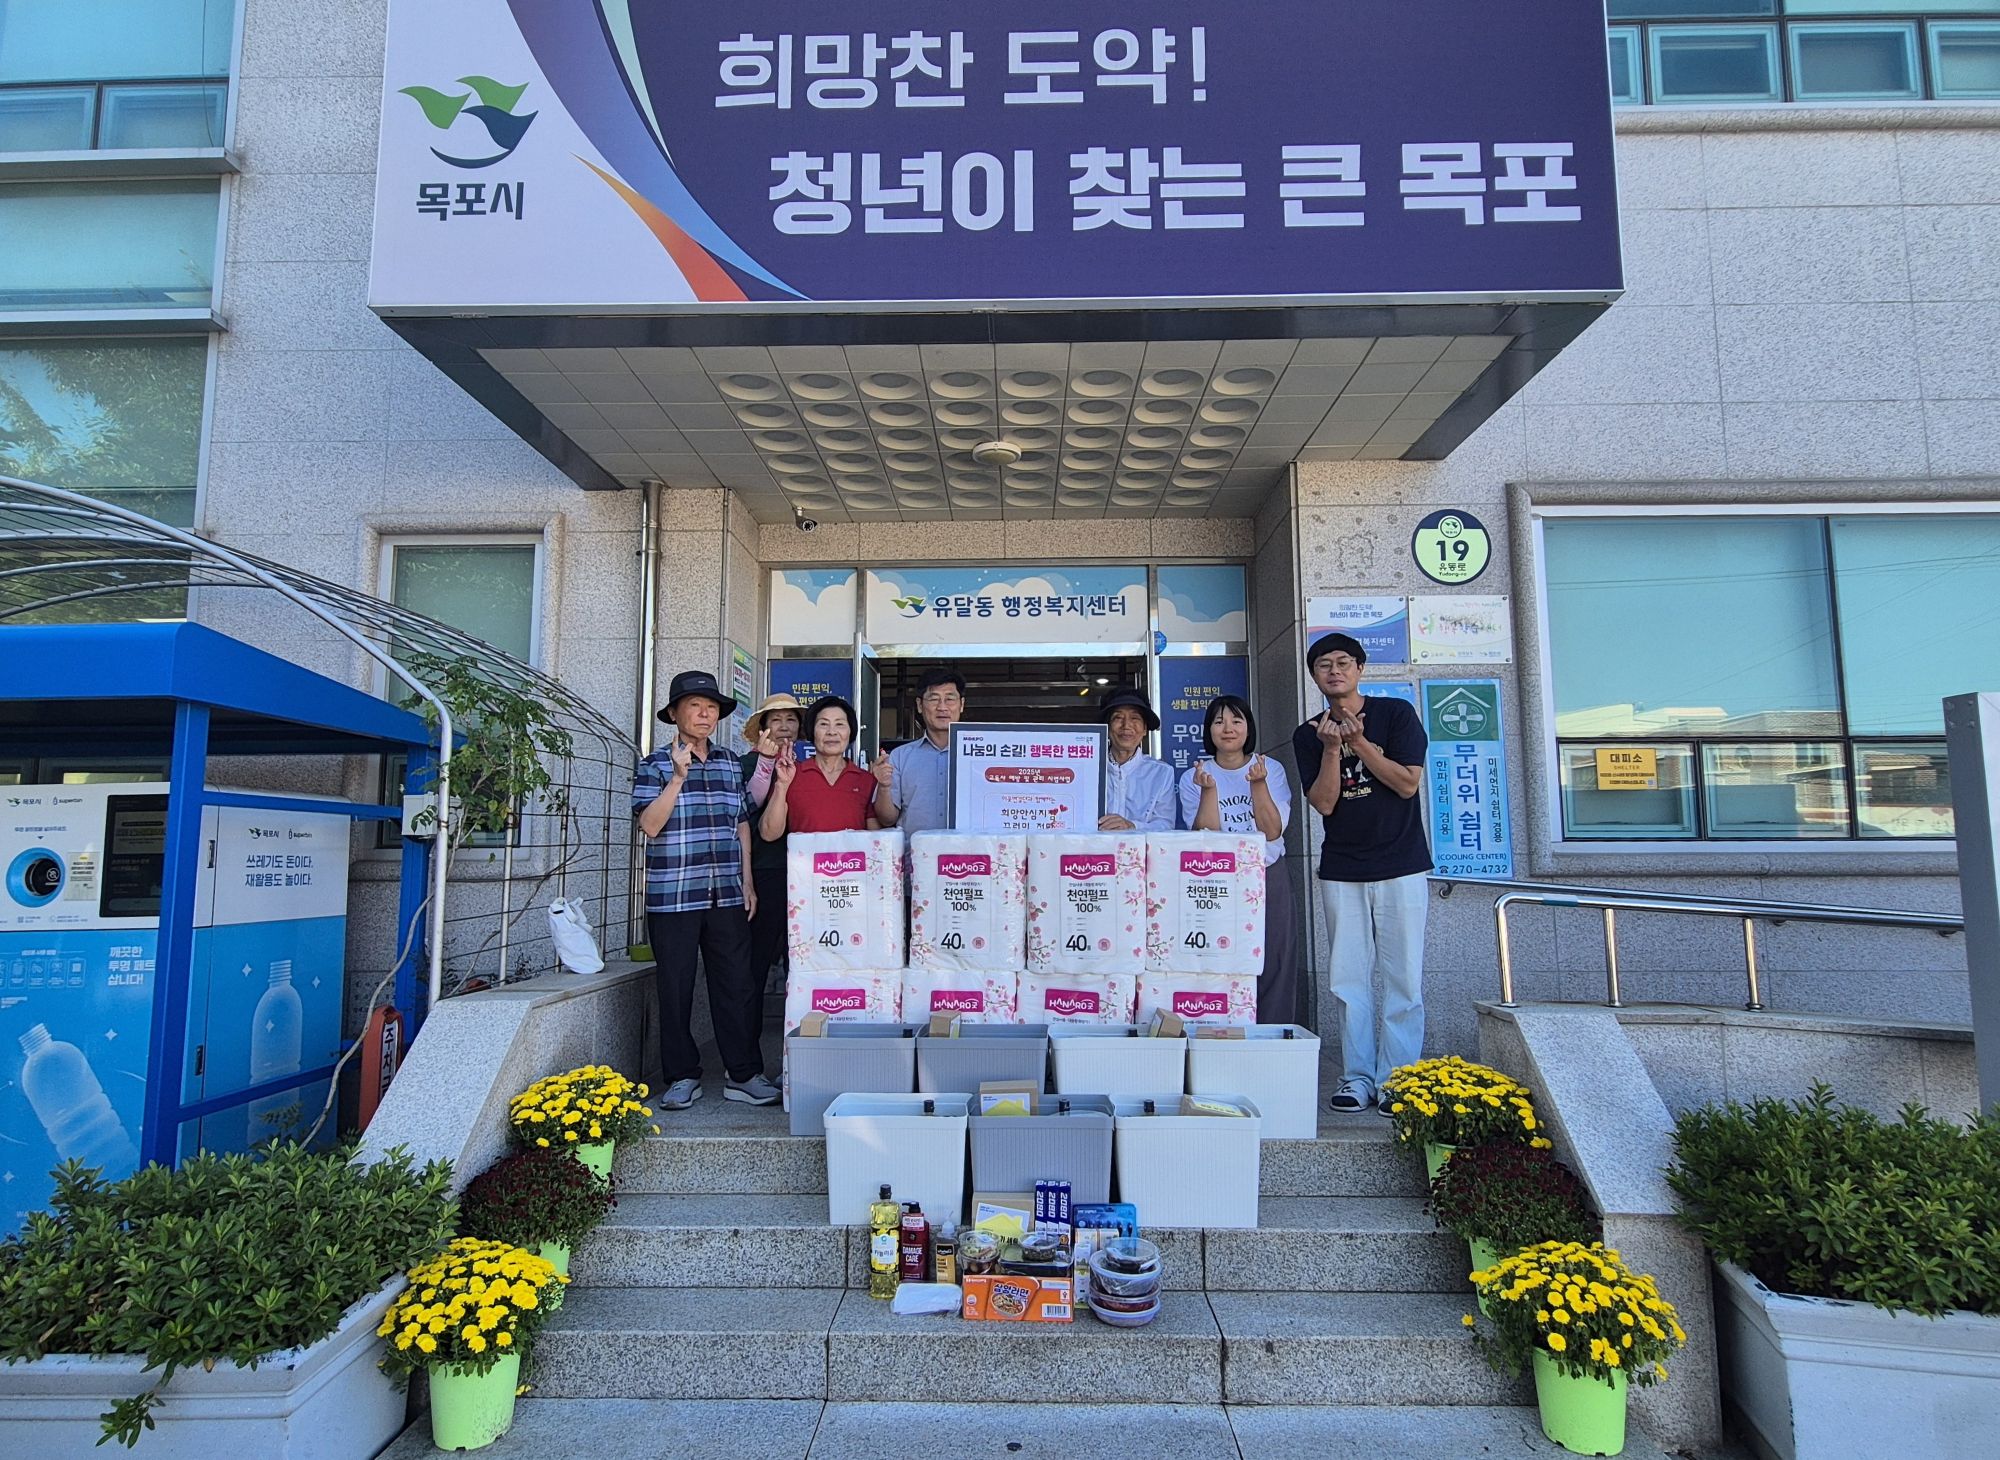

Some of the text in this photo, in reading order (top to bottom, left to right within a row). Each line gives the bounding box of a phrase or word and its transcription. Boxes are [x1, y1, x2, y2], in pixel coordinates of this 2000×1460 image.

[714, 26, 1207, 110] 희망찬 도약!
[768, 142, 1583, 235] 청년이 찾는 큰 목포
[416, 181, 525, 221] 목포시
[1436, 540, 1470, 561] 19
[1439, 562, 1467, 572] 유동로
[932, 595, 1127, 618] 유달동 행정복지센터
[792, 683, 810, 694] 민원
[1184, 686, 1201, 697] 민원
[1171, 699, 1189, 710] 생활
[1172, 724, 1204, 743] 무인
[963, 744, 1094, 759] 나눔의 손길! 행복한 변화!
[1610, 753, 1643, 763] 대피소
[1454, 744, 1482, 851] 무더위 쉼터
[246, 854, 314, 869] 쓰레기도 돈이다.
[1437, 853, 1507, 861] (COOLING CENTER)
[1452, 865, 1508, 875] 270-4732
[245, 873, 313, 887] 재활용도 놀이다.
[819, 885, 861, 898] 천연펄프
[943, 888, 984, 901] 천연펄프
[1066, 889, 1109, 902] 천연펄프
[1186, 885, 1229, 899] 천연펄프
[828, 898, 854, 909] 100%
[951, 901, 977, 911] 100%
[1075, 902, 1102, 913] 100%
[1194, 899, 1222, 910] 100%
[110, 946, 144, 958] 깨끗한
[108, 959, 156, 972] 투명 페트
[107, 974, 144, 986] 삽니다!
[1036, 1190, 1044, 1218] 2080
[1048, 1191, 1056, 1218] 2080
[1060, 1192, 1068, 1219] 2080
[902, 1246, 923, 1255] DAMAGE
[905, 1254, 919, 1263] CARE
